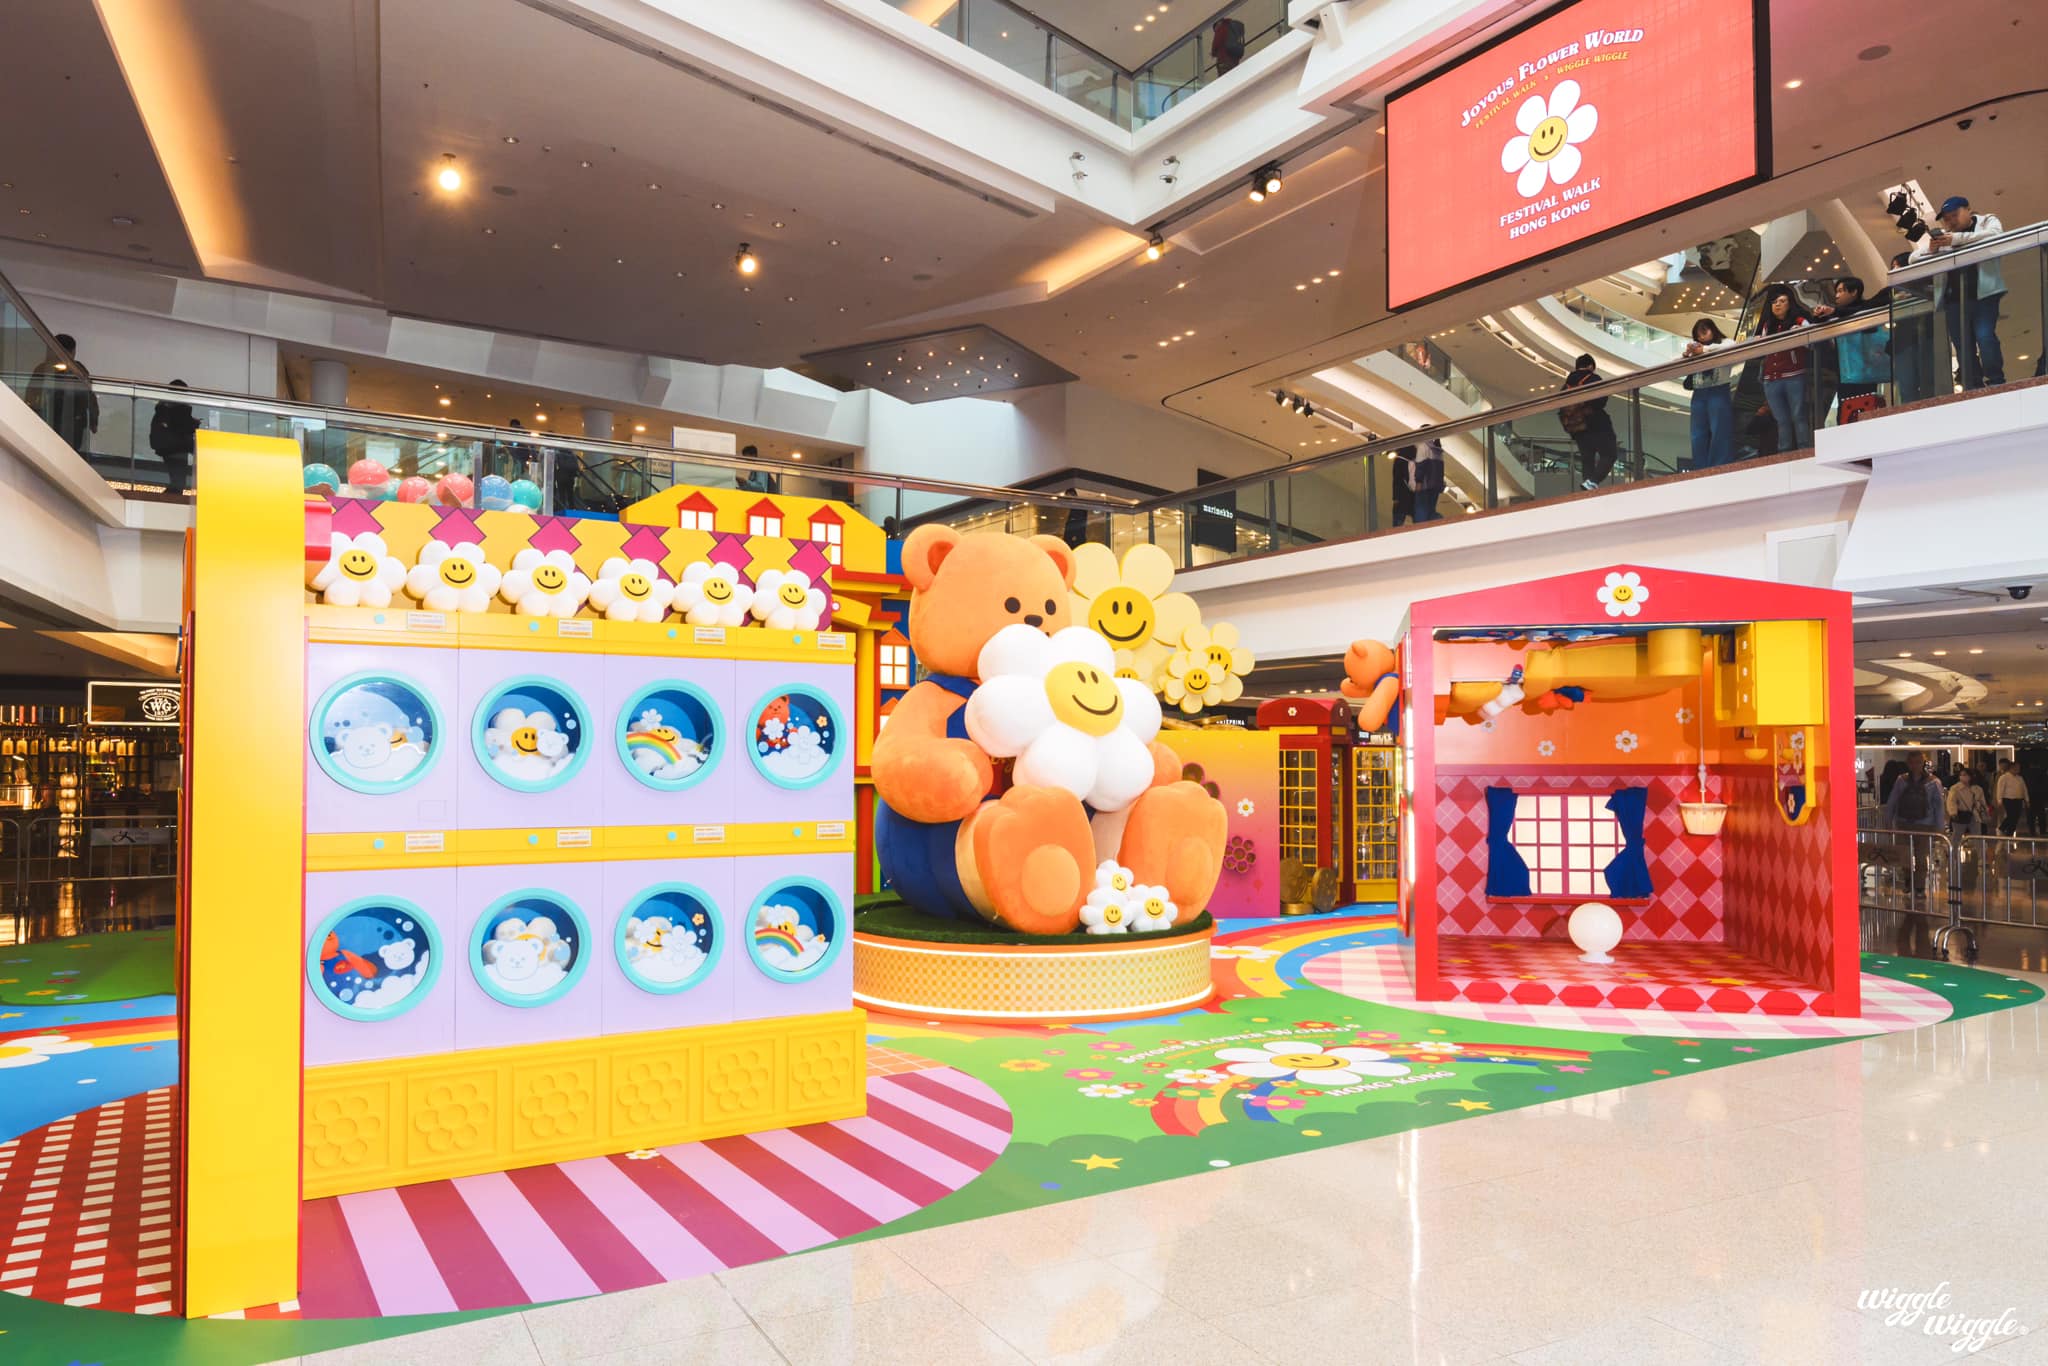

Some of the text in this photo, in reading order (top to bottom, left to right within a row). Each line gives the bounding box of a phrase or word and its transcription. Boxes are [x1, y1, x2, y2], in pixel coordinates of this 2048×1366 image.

[1584, 28, 1645, 51] WORLD
[1556, 58, 1591, 75] WIGGLE
[1593, 51, 1629, 64] WIGGLE
[1499, 177, 1602, 227] FESTIVAL WALK
[1509, 199, 1592, 240] HONG KONG
